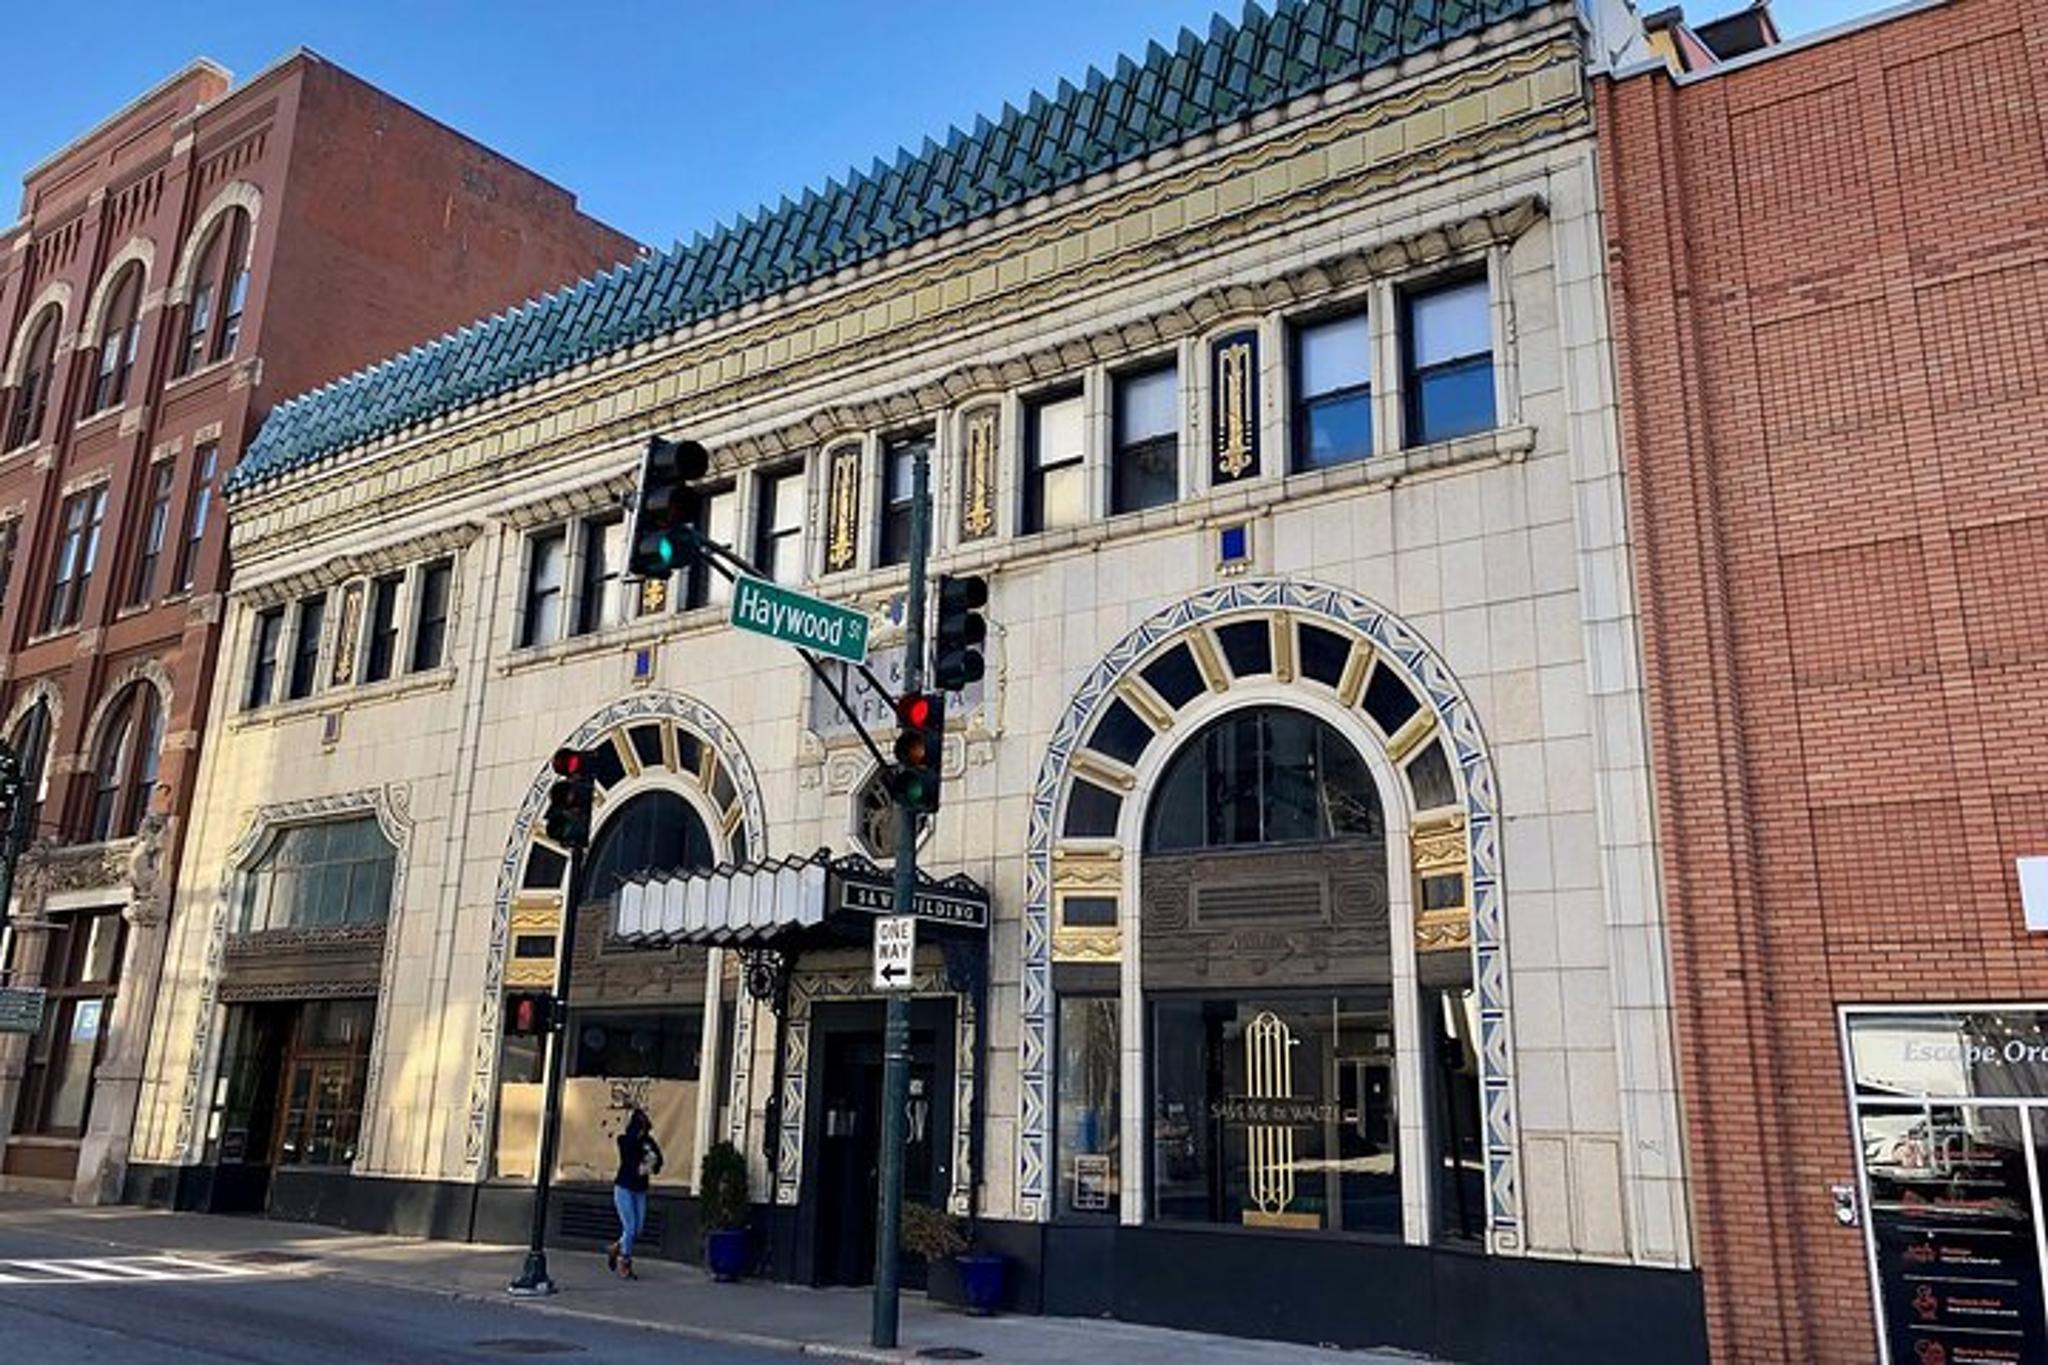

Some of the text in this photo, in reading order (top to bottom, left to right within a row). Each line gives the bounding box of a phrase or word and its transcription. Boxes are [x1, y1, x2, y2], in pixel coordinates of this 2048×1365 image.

[738, 585, 863, 647] Haywood St
[912, 896, 974, 920] ILDING
[879, 920, 910, 940] ONE
[878, 943, 911, 960] WAY
[1904, 1040, 1996, 1069] Escape
